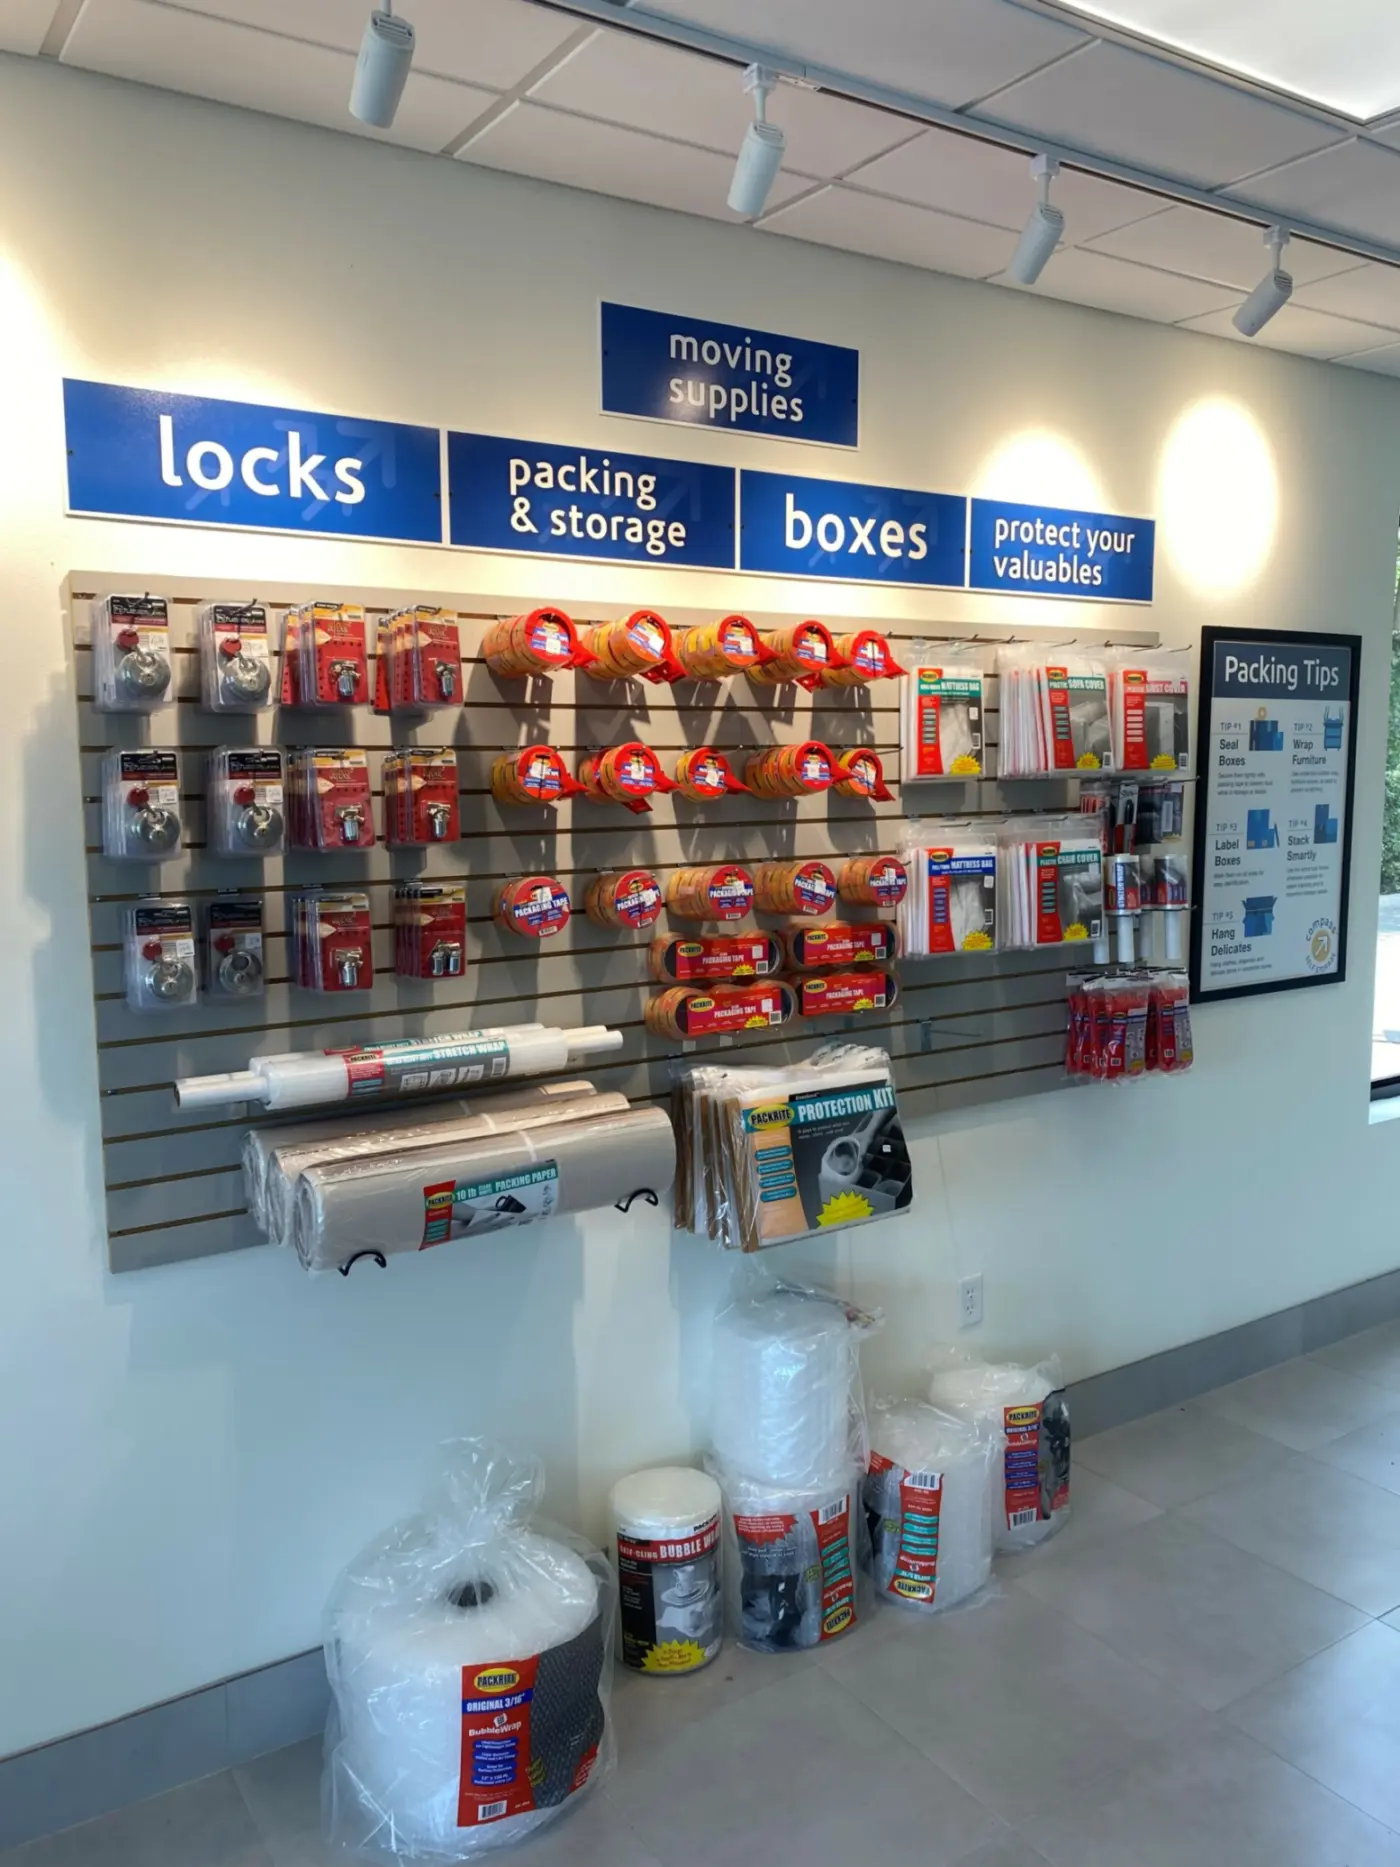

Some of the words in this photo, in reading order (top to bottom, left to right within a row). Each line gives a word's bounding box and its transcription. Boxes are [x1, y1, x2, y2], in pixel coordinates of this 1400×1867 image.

[669, 333, 793, 387] moving
[668, 376, 804, 422] supplies
[159, 414, 366, 505] locks
[509, 457, 656, 510] packing
[510, 497, 538, 533] &
[550, 504, 686, 556] storage
[785, 493, 928, 561] boxes
[995, 516, 1081, 550] protect
[1086, 525, 1135, 555] your
[994, 551, 1102, 586] valuables
[1224, 655, 1298, 691] Packing
[1303, 659, 1339, 691] Tips
[1220, 722, 1232, 731] TIP
[1294, 723, 1304, 731] TIP
[1219, 738, 1239, 750] Seal
[1293, 739, 1314, 752] Wrap
[1218, 755, 1246, 766] Boxes
[1292, 754, 1327, 765] Furniture
[1216, 823, 1228, 832] TIP
[1289, 820, 1299, 829] TIP
[1215, 839, 1240, 850] Label
[1288, 835, 1310, 846] Stack
[1214, 855, 1241, 866] Boxes
[1287, 850, 1317, 862] Smartly
[1212, 911, 1224, 921] TIP
[1211, 927, 1236, 940] Hang
[1305, 917, 1337, 942] compass
[1210, 943, 1252, 956] Delicates
[702, 955, 732, 964] PACKAGING
[732, 954, 744, 962] TAPE
[714, 1008, 744, 1018] PACKAGING
[744, 1006, 757, 1014] TAPE
[432, 1045, 477, 1059] STRETCH
[476, 1041, 504, 1053] WRAP
[797, 1093, 873, 1122] PROTECTION
[872, 1086, 895, 1108] KIT
[750, 1109, 790, 1125] PACKRITE
[456, 1190, 466, 1201] 10
[495, 1173, 531, 1192] PACKING
[531, 1167, 557, 1183] PAPER
[660, 1539, 702, 1559] BUBBLE
[477, 1672, 517, 1688] PACKRITE
[466, 1699, 504, 1712] ORIGINAL
